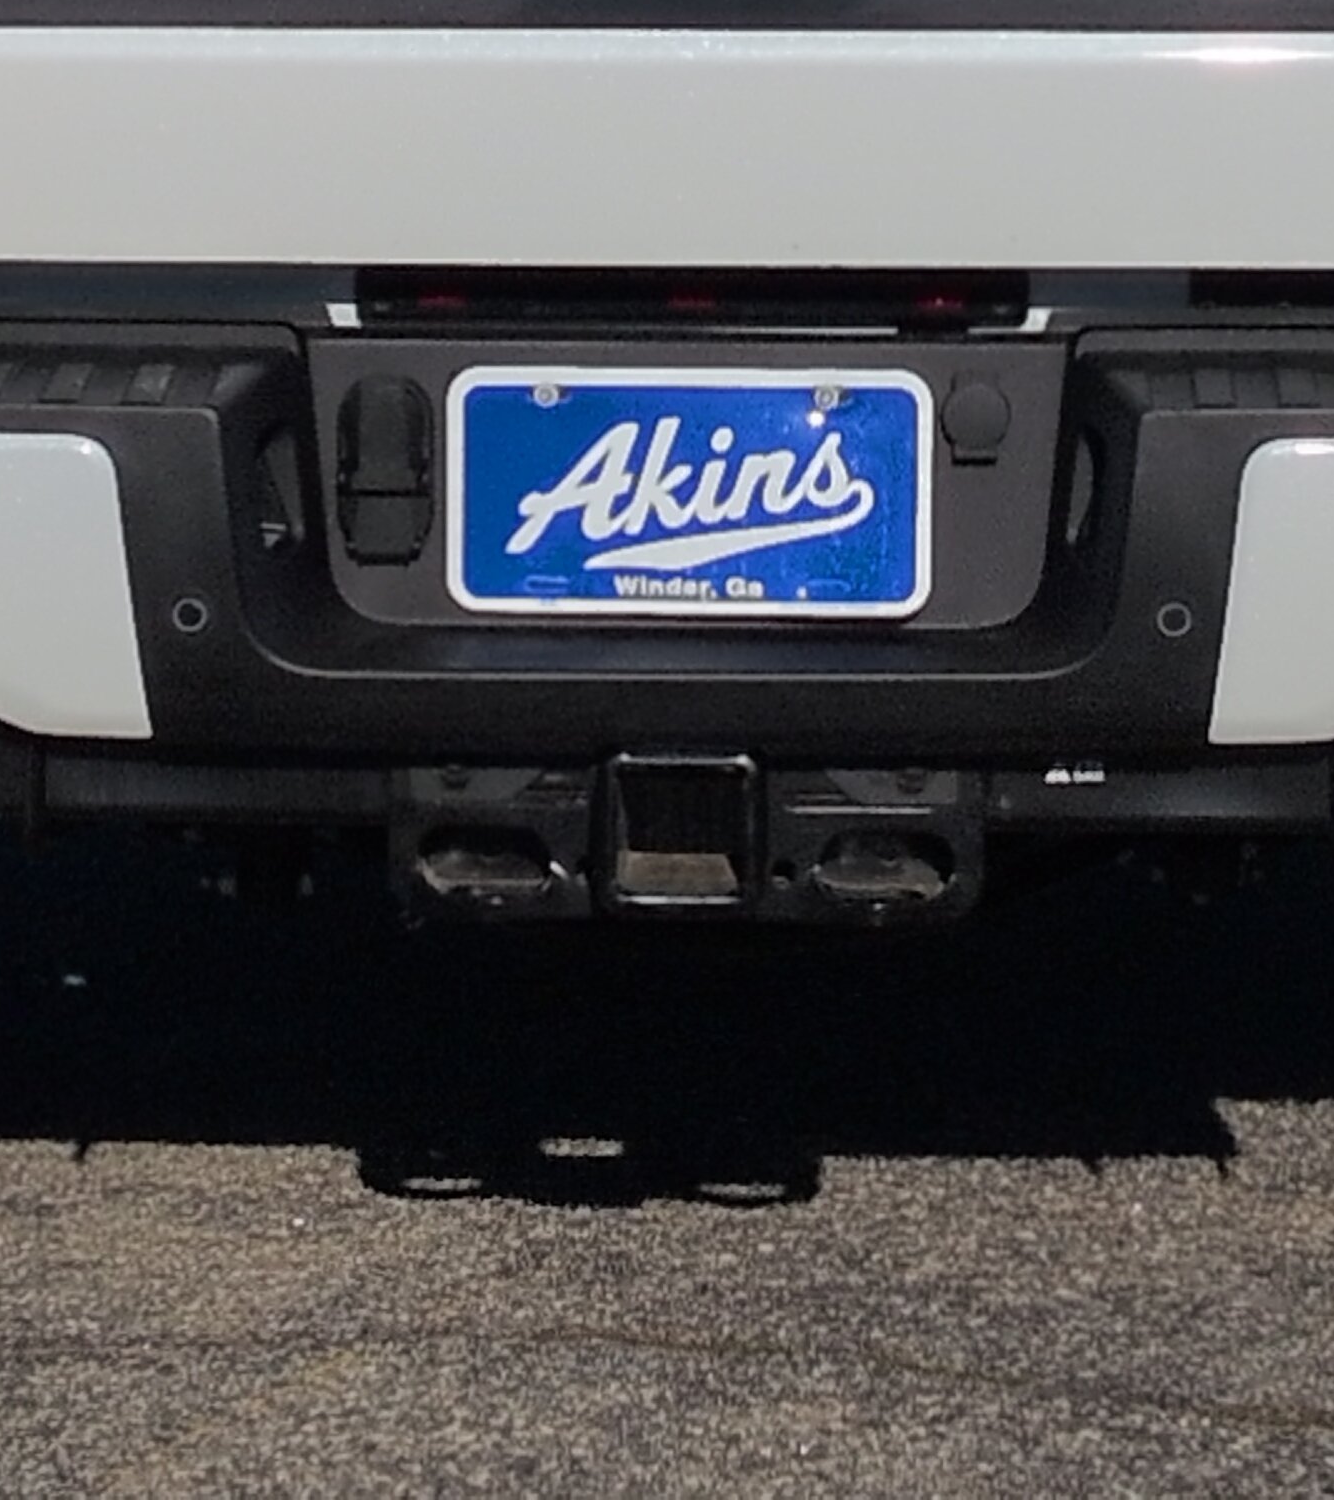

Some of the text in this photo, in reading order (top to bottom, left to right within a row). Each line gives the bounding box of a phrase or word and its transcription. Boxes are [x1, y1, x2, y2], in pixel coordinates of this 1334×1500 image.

[504, 415, 875, 566] Akins
[613, 574, 765, 601] Winder, Ga
